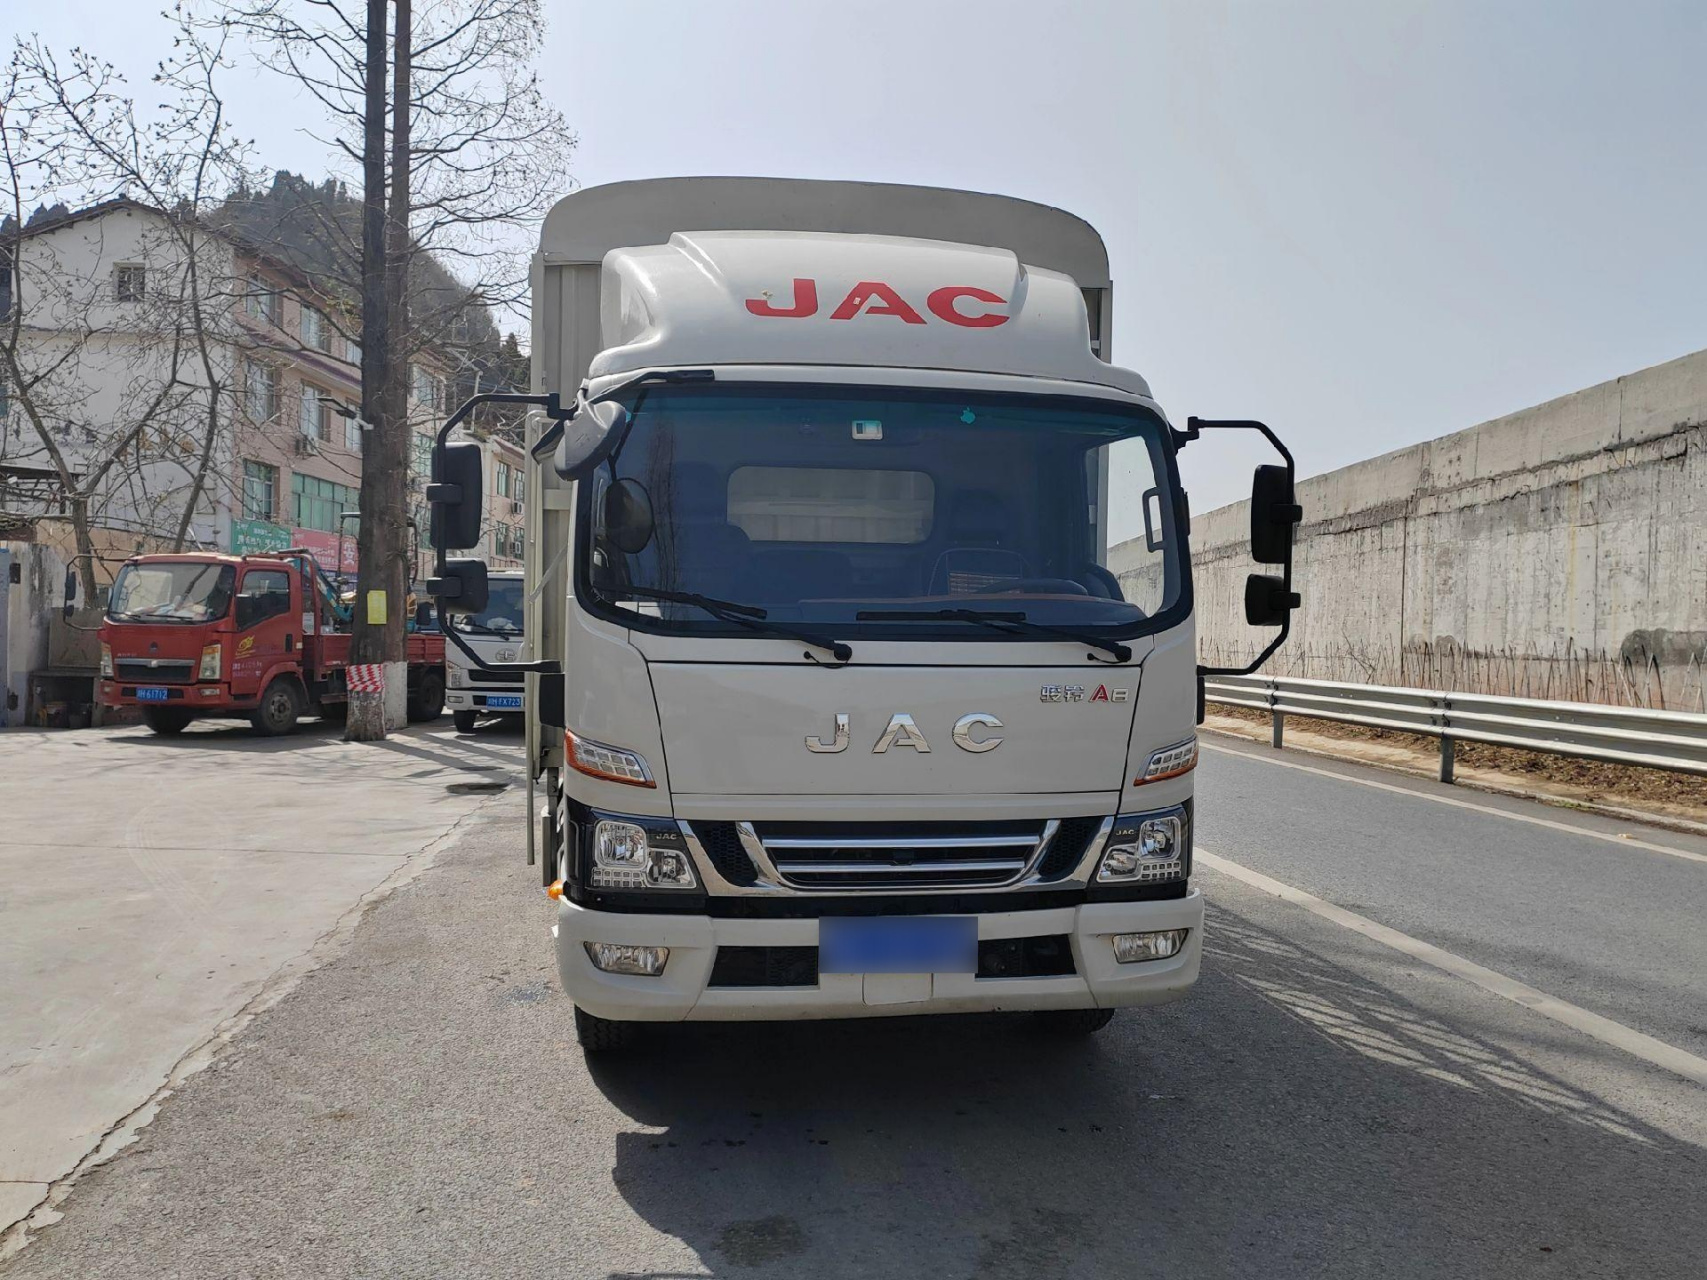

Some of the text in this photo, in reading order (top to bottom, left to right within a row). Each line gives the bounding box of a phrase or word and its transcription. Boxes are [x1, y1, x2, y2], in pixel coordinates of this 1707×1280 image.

[745, 277, 1011, 328] JAC
[1040, 684, 1085, 702] 骏铃
[804, 712, 1005, 754] JAC
